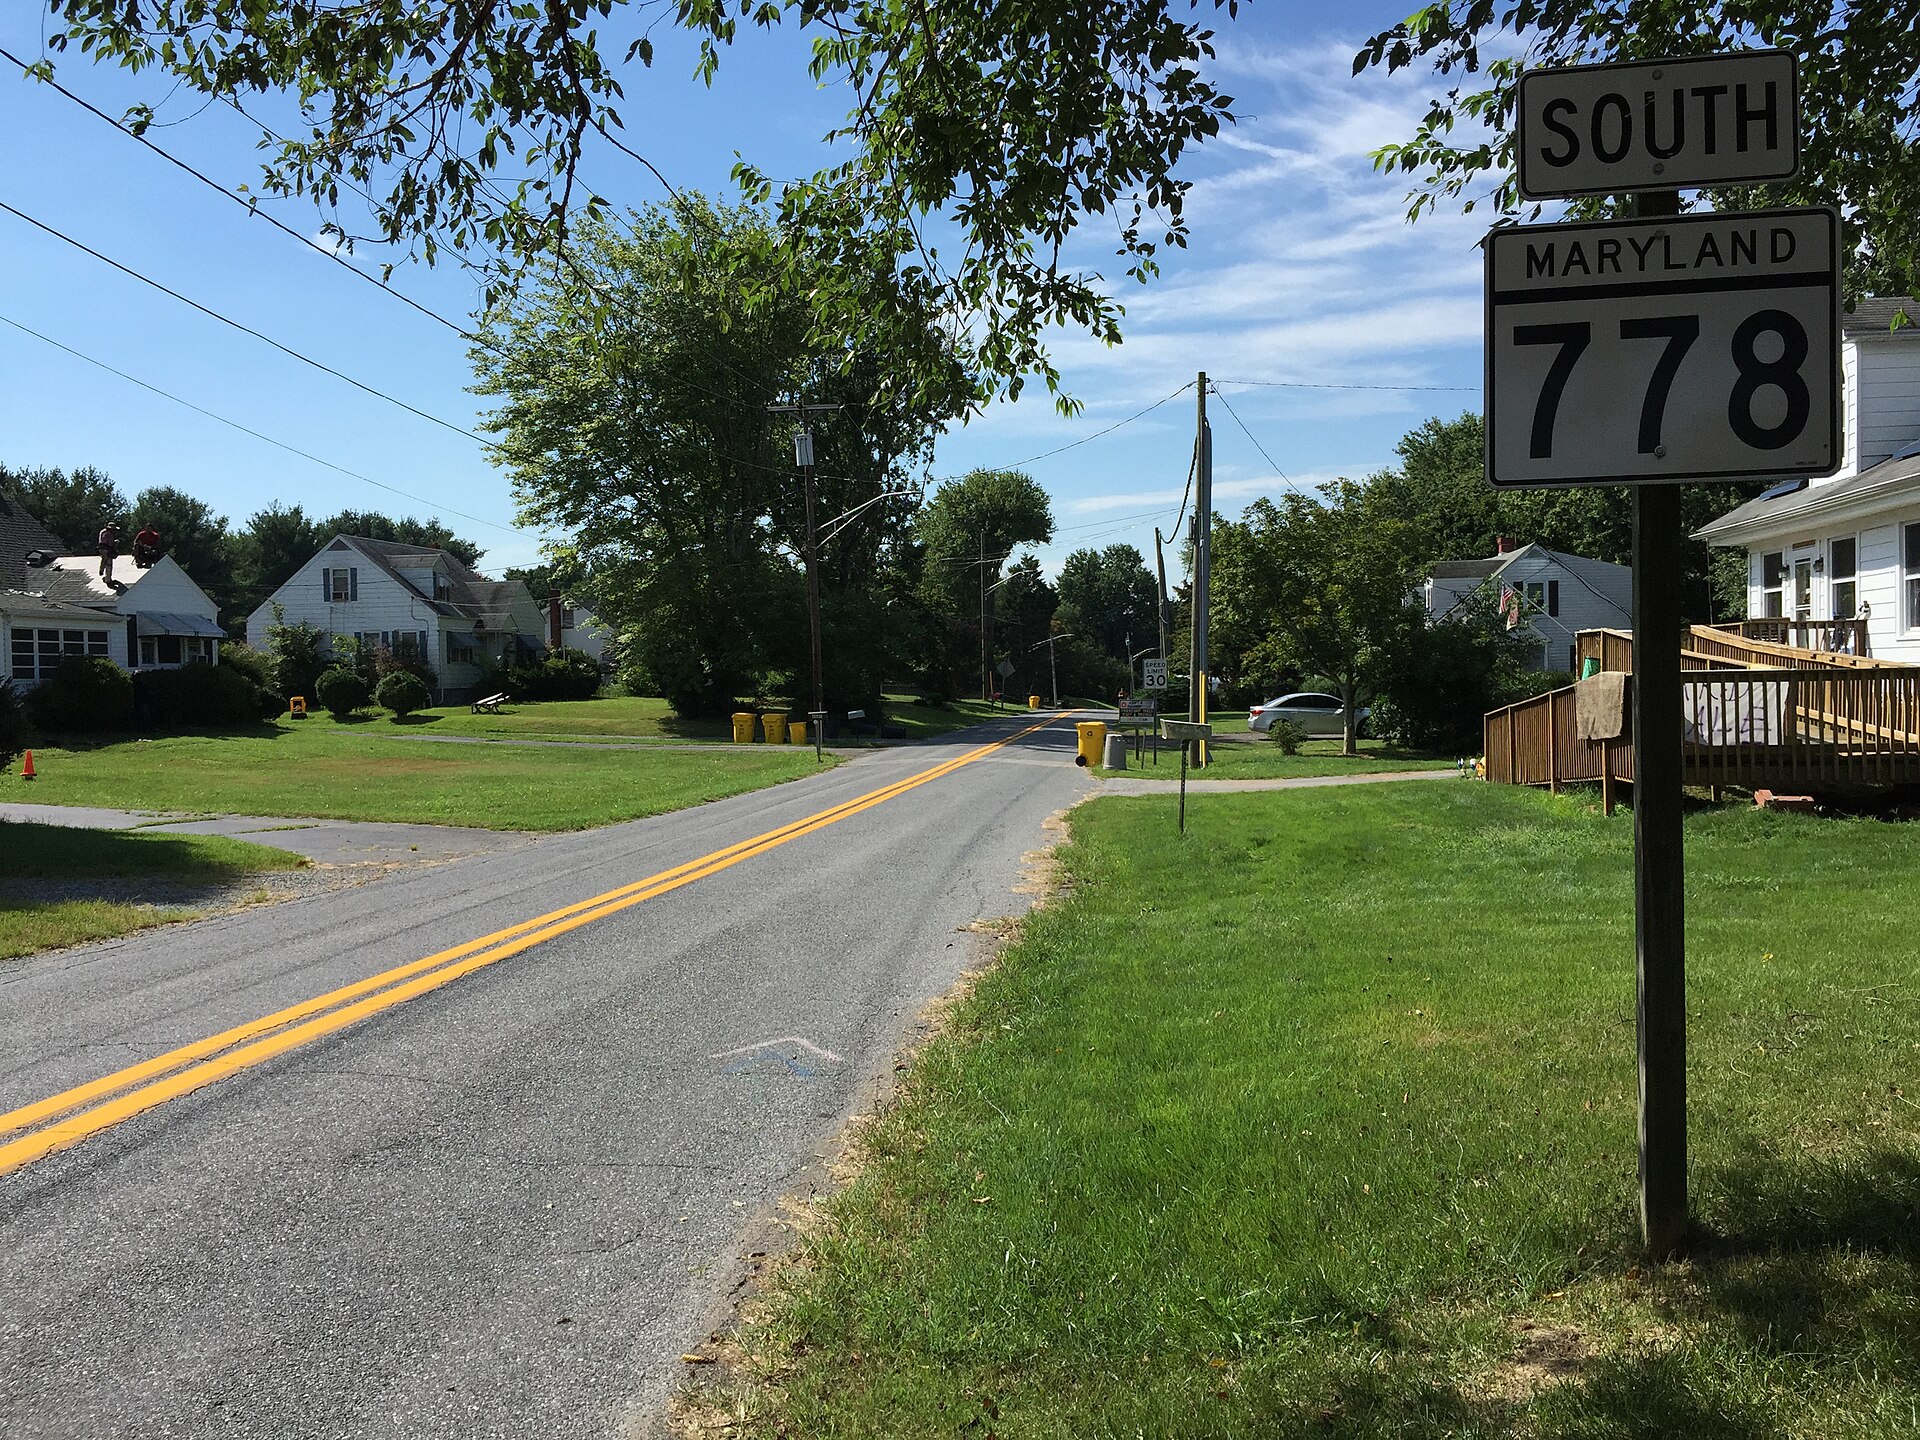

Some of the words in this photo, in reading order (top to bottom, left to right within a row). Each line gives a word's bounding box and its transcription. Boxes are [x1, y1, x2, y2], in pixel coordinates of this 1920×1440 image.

[1541, 81, 1778, 167] SOUTH
[1526, 227, 1797, 279] MARYLAND
[1513, 309, 1811, 459] 778
[1146, 675, 1166, 686] 30
